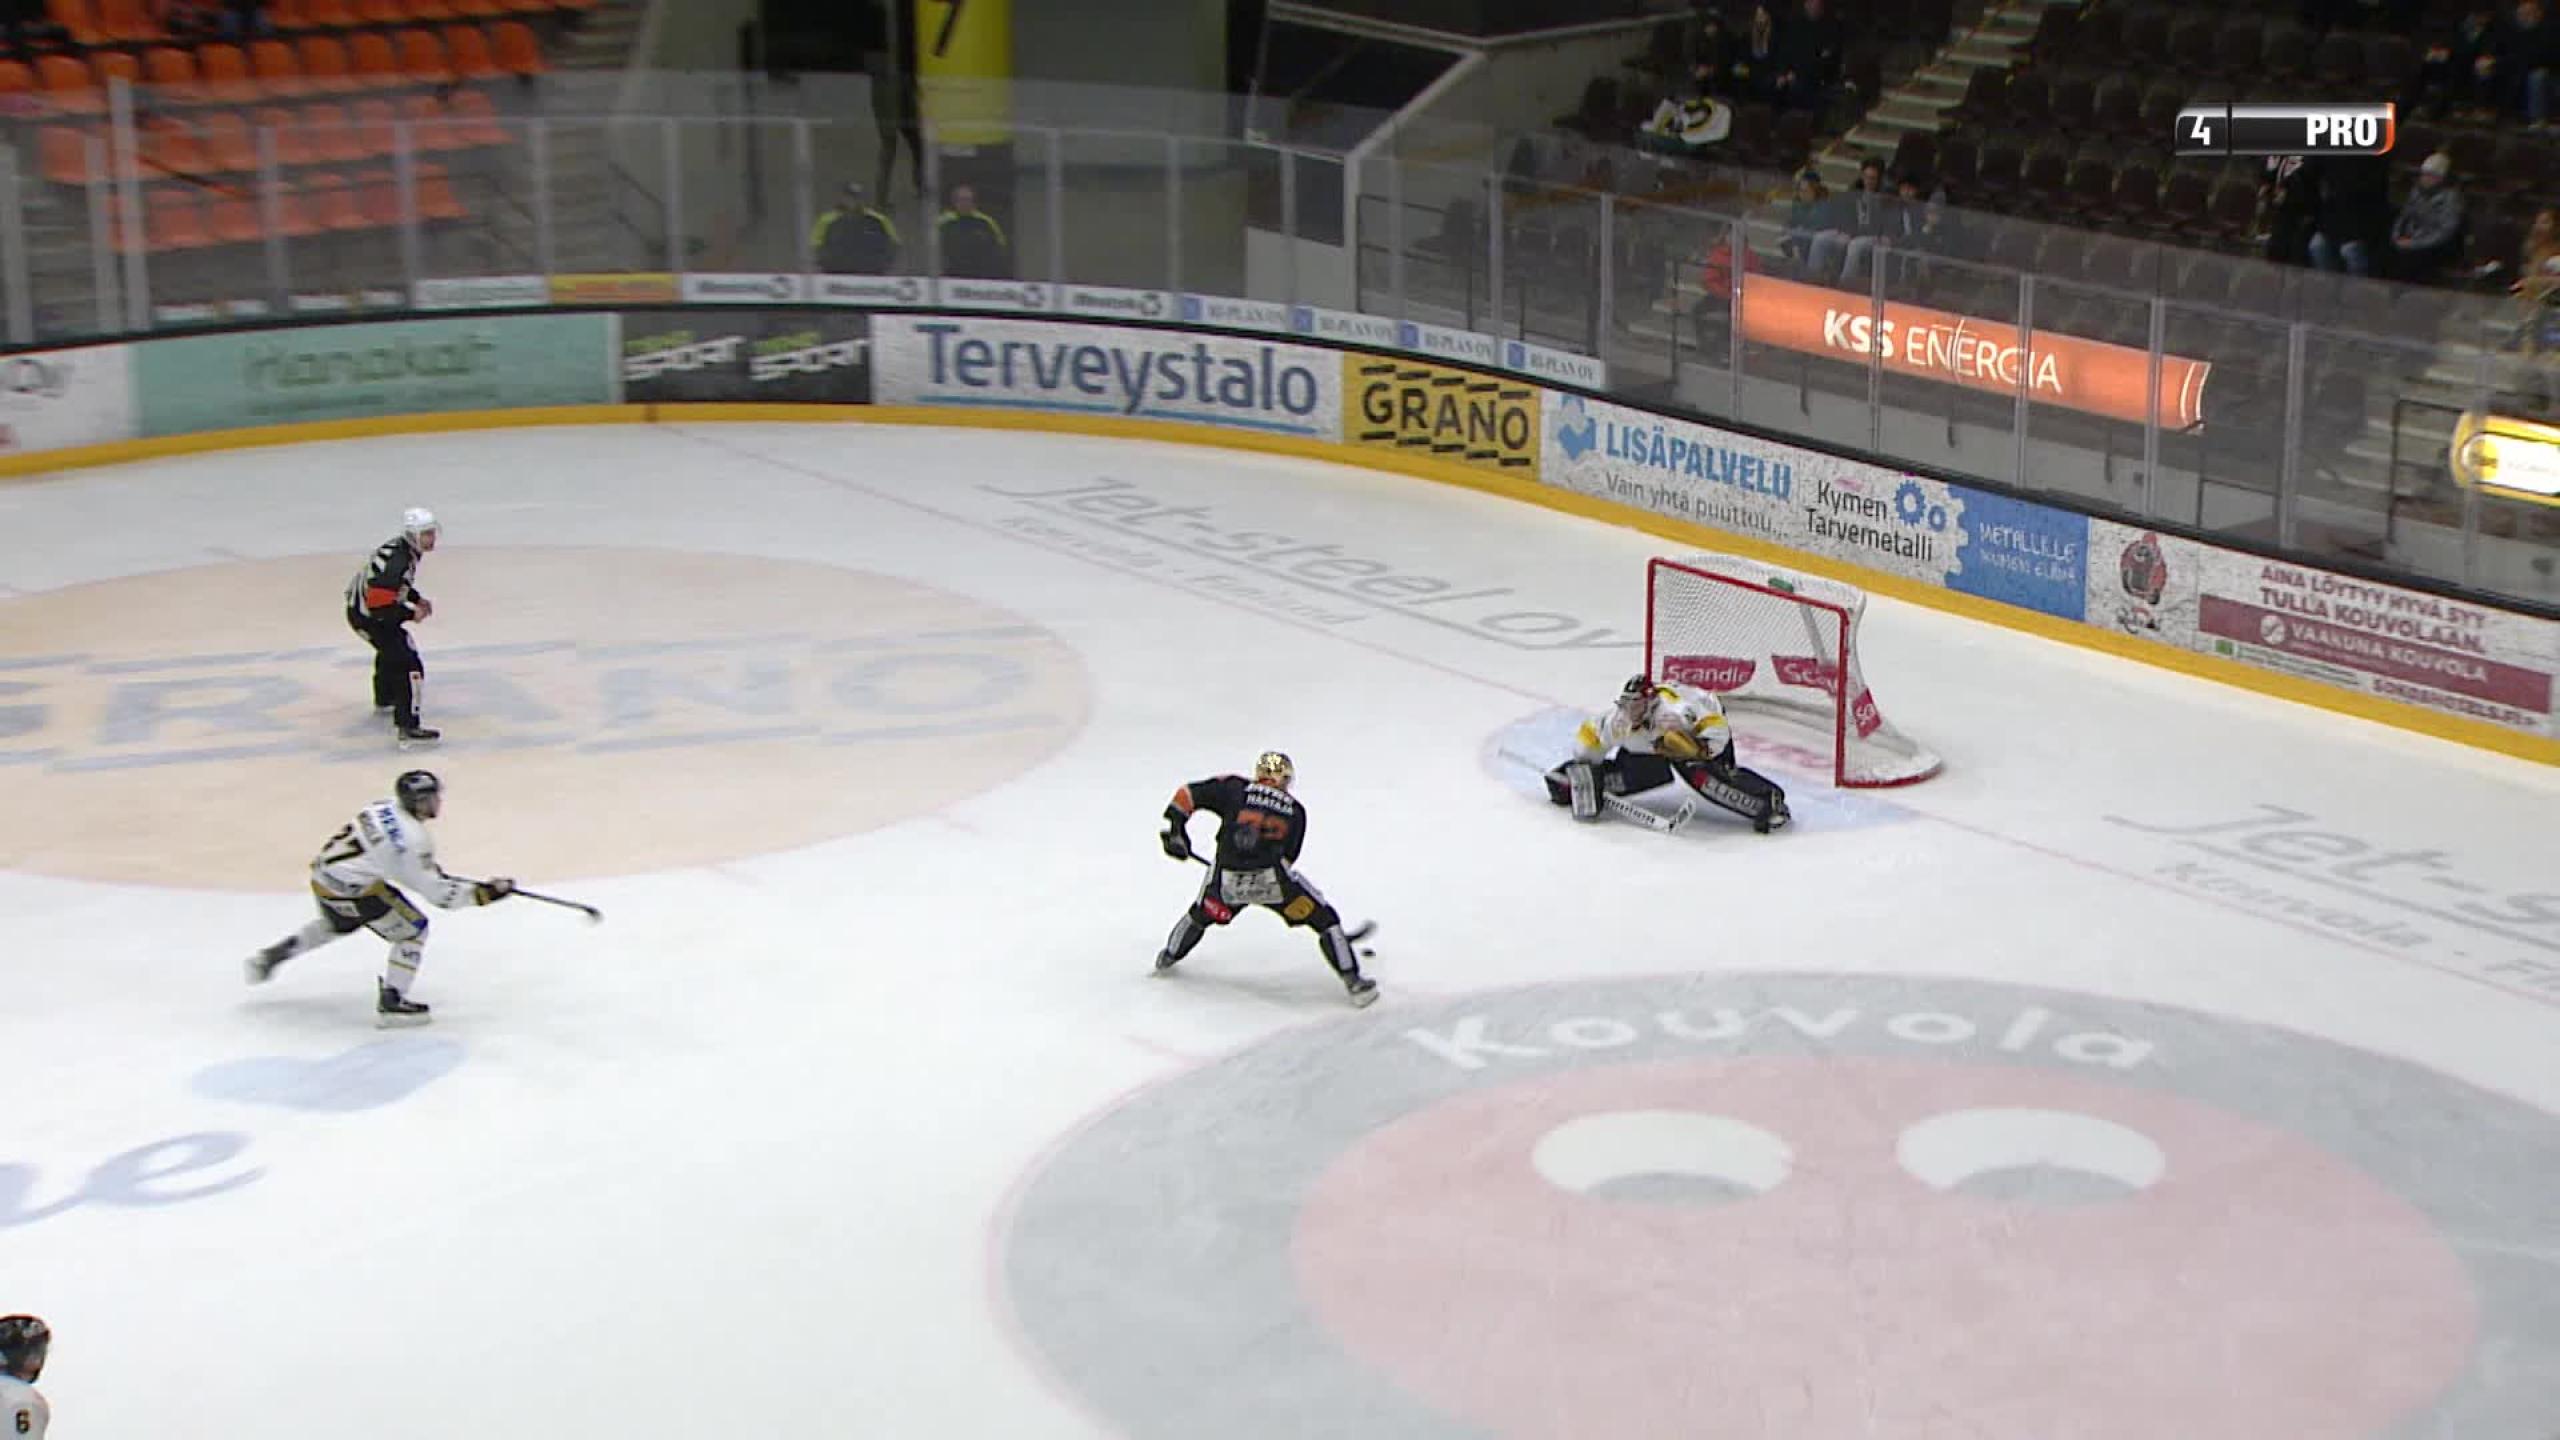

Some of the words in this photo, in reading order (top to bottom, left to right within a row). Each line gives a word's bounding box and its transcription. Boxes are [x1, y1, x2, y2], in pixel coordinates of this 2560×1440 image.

[915, 322, 1319, 414] Terveystalo
[1823, 308, 1894, 358] KSS
[1906, 320, 2063, 394] ENERGIA
[1362, 383, 1531, 452] GRANO
[1606, 422, 1791, 503] LISÄPALVELU
[1606, 471, 1645, 501] Vain
[1650, 482, 1689, 513] yhtä
[1818, 479, 1887, 522] Kymen
[1805, 507, 1932, 562] Tarvemetalli
[2260, 586, 2329, 618] TULLA
[0, 652, 1032, 746] RANO
[1404, 1008, 2156, 1068] Kouvola
[16, 1408, 31, 1434] 6
